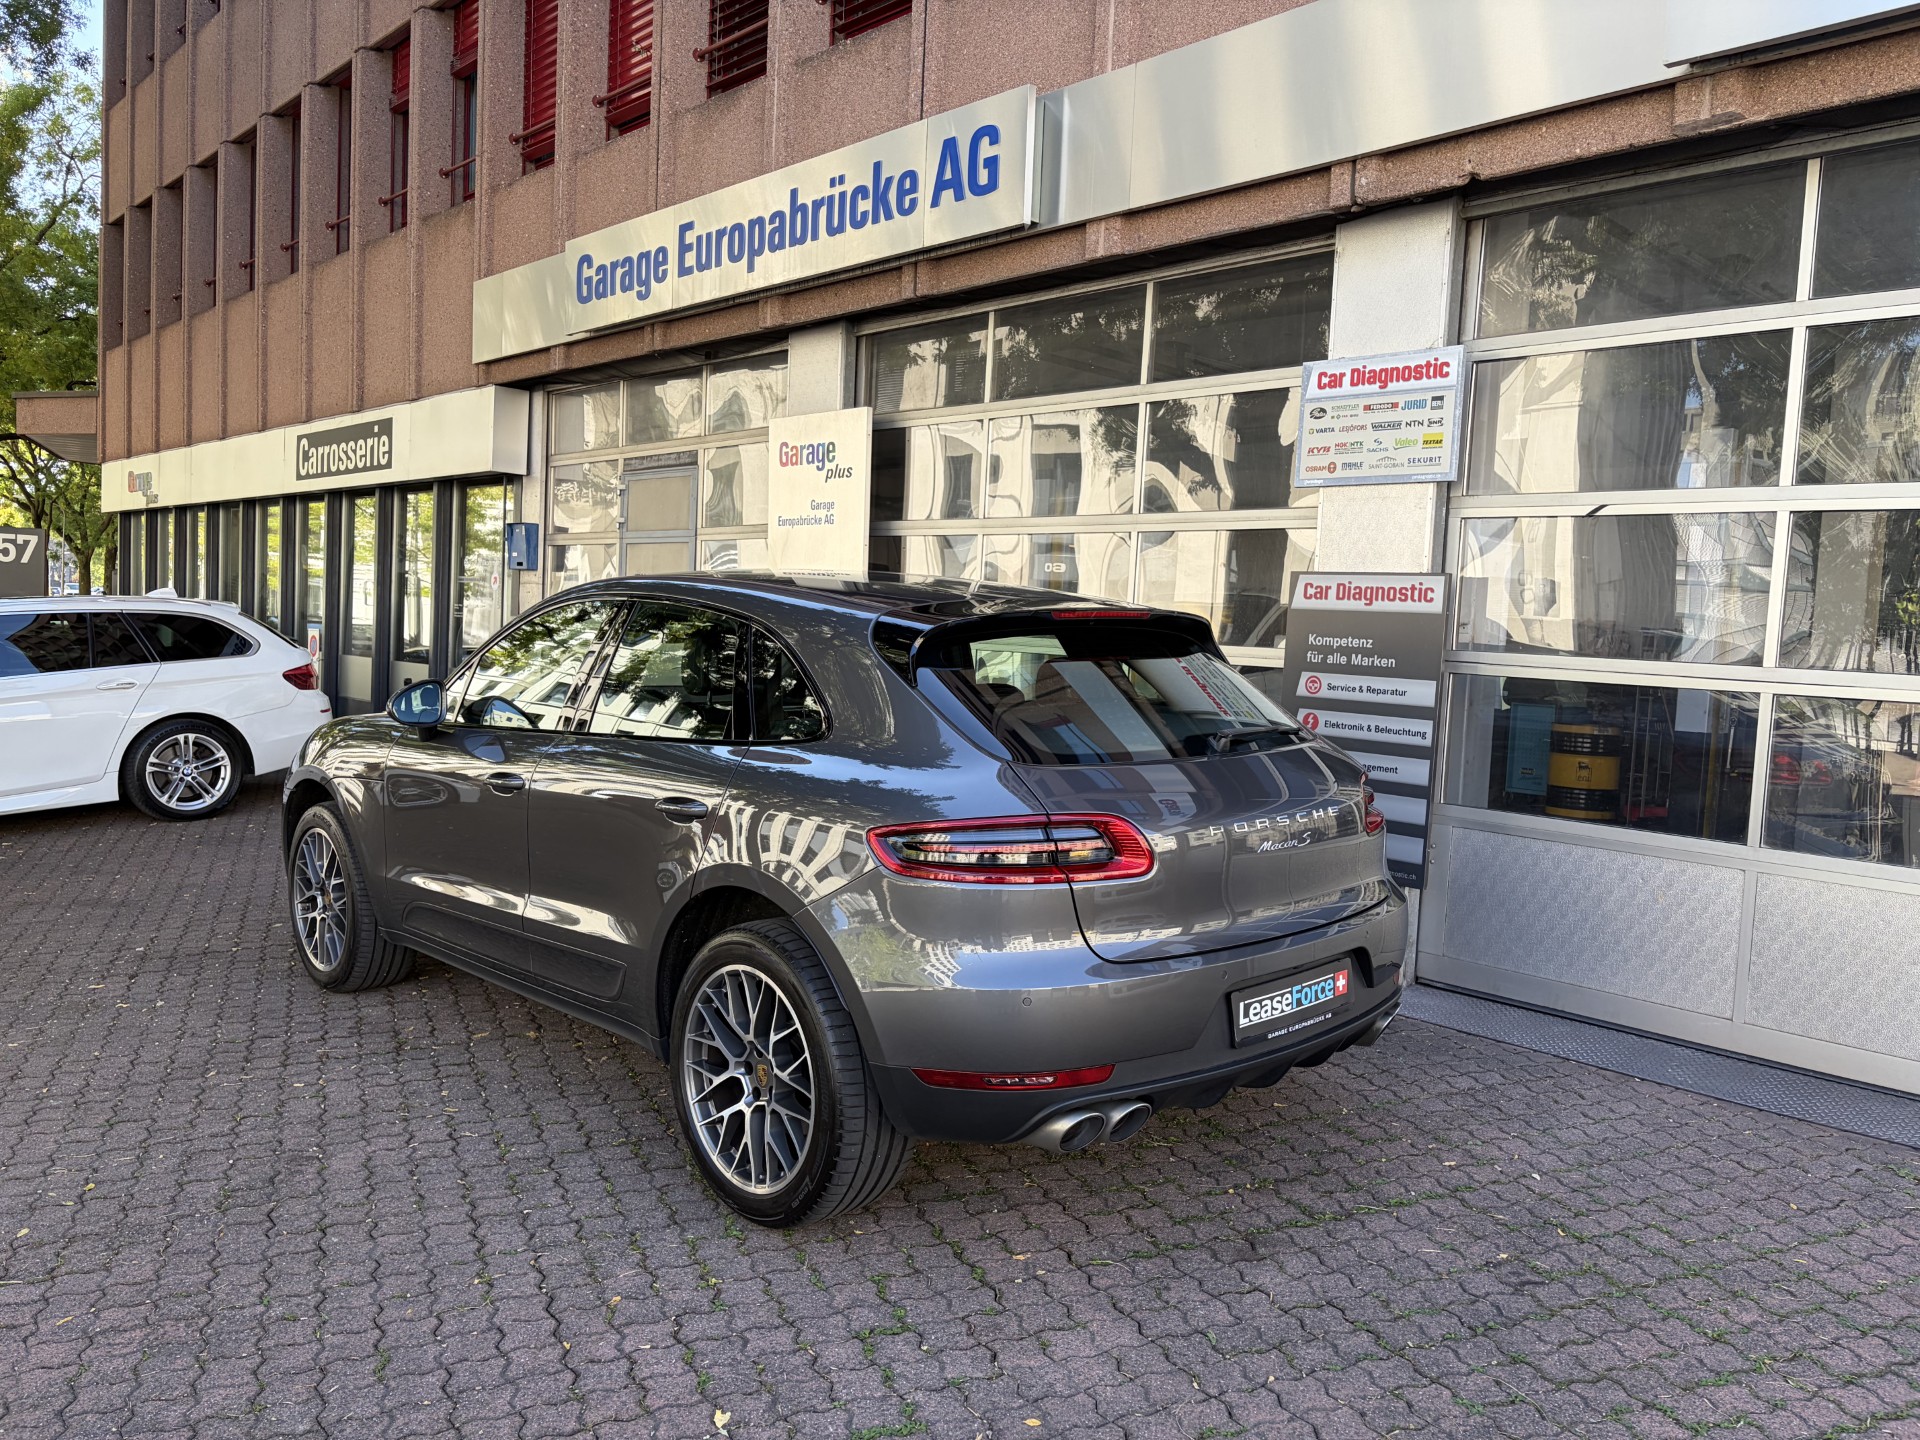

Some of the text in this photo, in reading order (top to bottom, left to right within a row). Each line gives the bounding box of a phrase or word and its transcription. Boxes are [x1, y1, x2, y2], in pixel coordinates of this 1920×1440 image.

[575, 124, 1001, 303] Garage Europabrücke AG
[1317, 357, 1450, 390] Car Diagnostic
[1401, 399, 1427, 410] JURID
[1371, 421, 1402, 430] WALKER
[1405, 420, 1424, 428] NTN
[299, 425, 389, 476] Carrosserie
[779, 441, 836, 471] Garage
[1307, 446, 1331, 454] KYB
[1305, 465, 1327, 473] OSRAM
[1407, 456, 1442, 464] SEKURIT
[825, 464, 853, 483] plus
[810, 499, 835, 512] Garage
[778, 513, 835, 529] Europabrücke AG
[0, 533, 38, 563] 57
[1303, 581, 1435, 607] Car Diagnostic
[1308, 633, 1373, 649] Kompetenz
[1306, 650, 1396, 668] für alle Marken
[1327, 682, 1408, 697] Service & Reparatur
[1324, 719, 1427, 740] Elektronik & Beleuchtung
[1210, 806, 1339, 836] PORSCHE
[1257, 832, 1312, 853] Macan S
[1239, 978, 1334, 1025] LeaseForce
[1268, 1028, 1288, 1039] GARAGE
